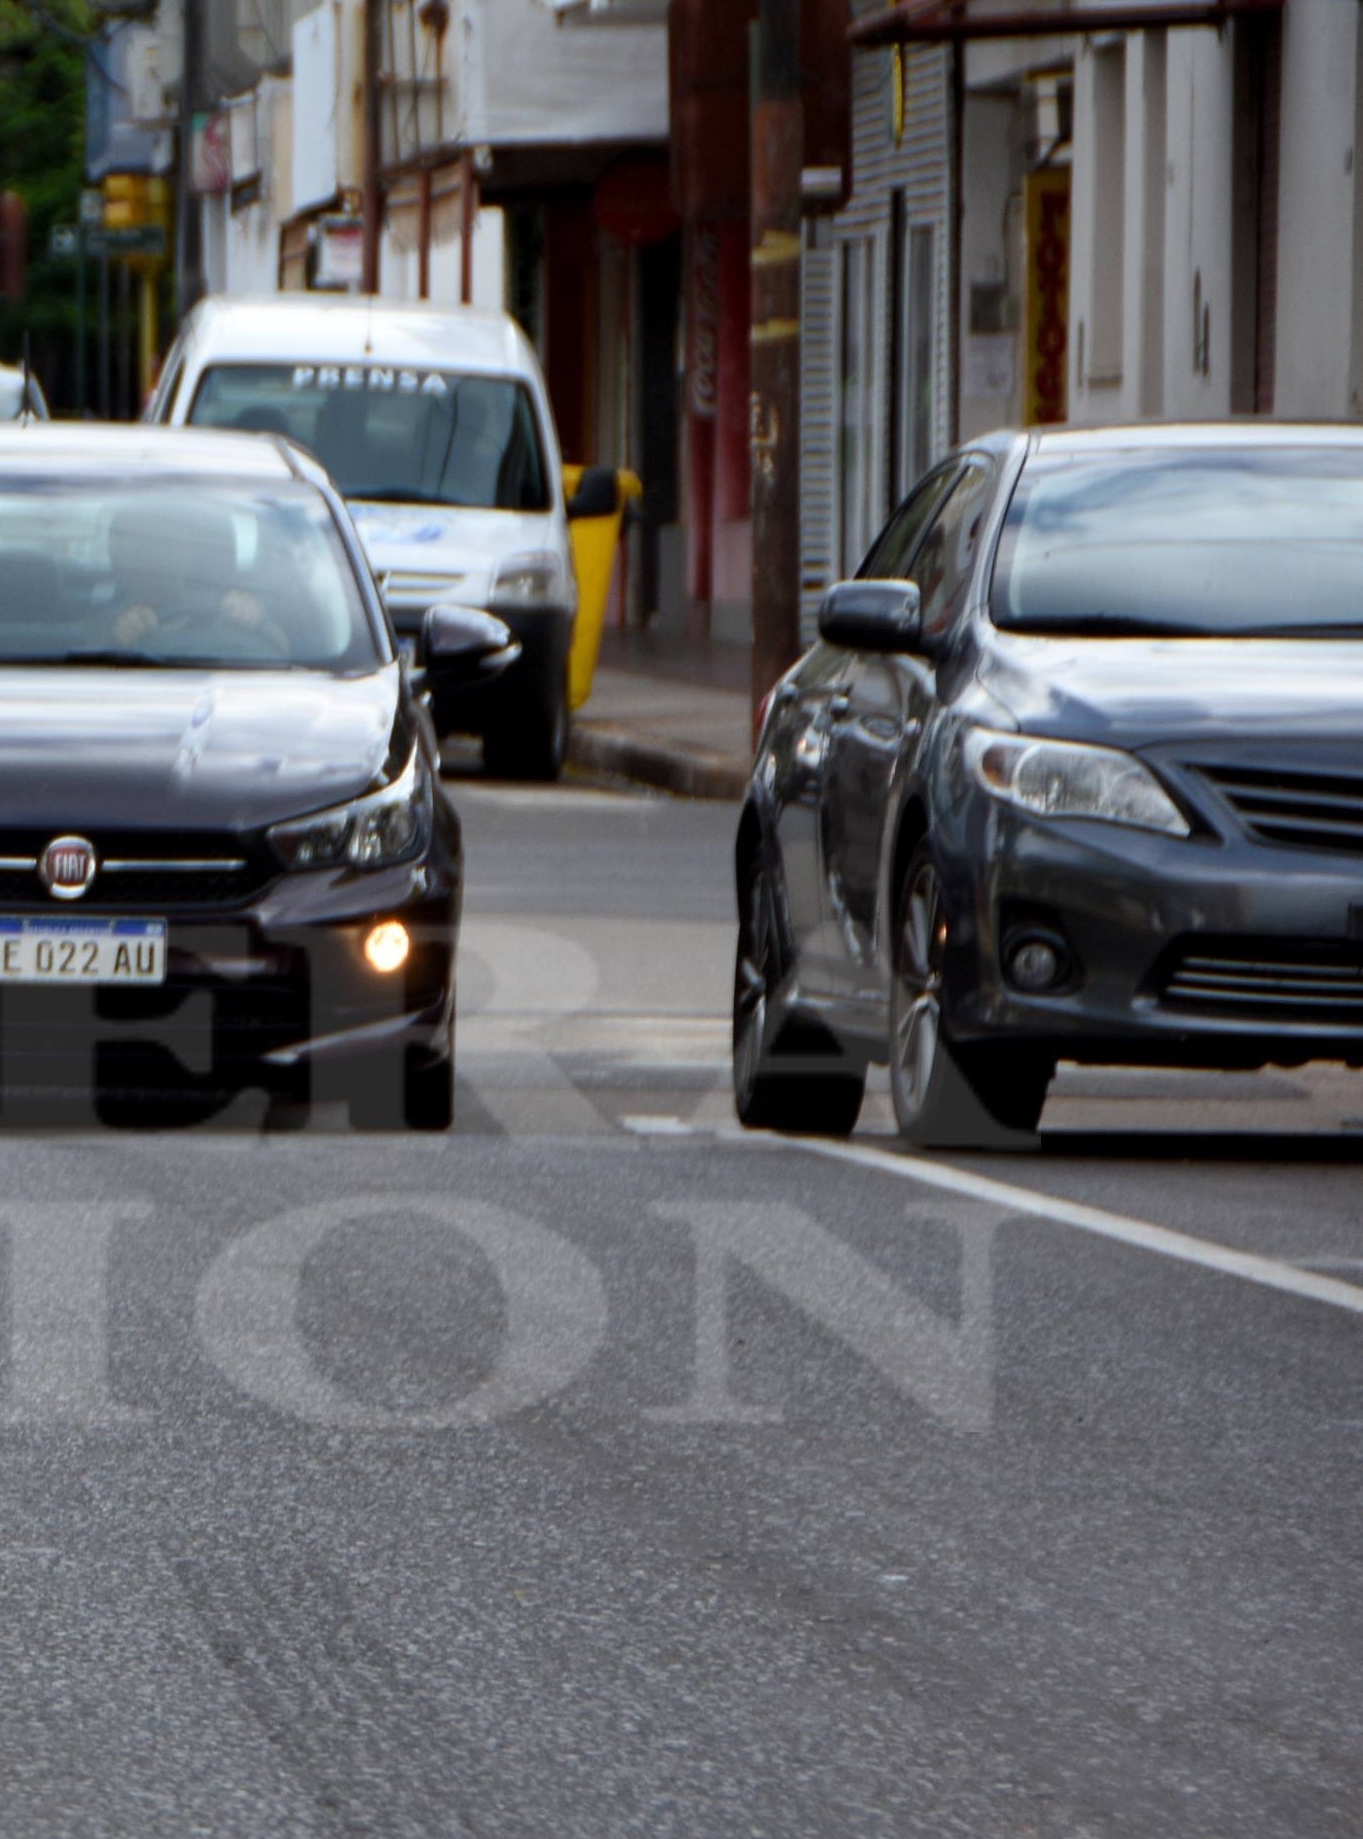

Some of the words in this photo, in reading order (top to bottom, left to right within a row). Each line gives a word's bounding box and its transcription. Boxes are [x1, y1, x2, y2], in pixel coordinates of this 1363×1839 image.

[292, 365, 447, 395] PRENSA
[53, 853, 86, 881] FIAT
[35, 940, 100, 974] 022
[113, 941, 155, 975] AU
